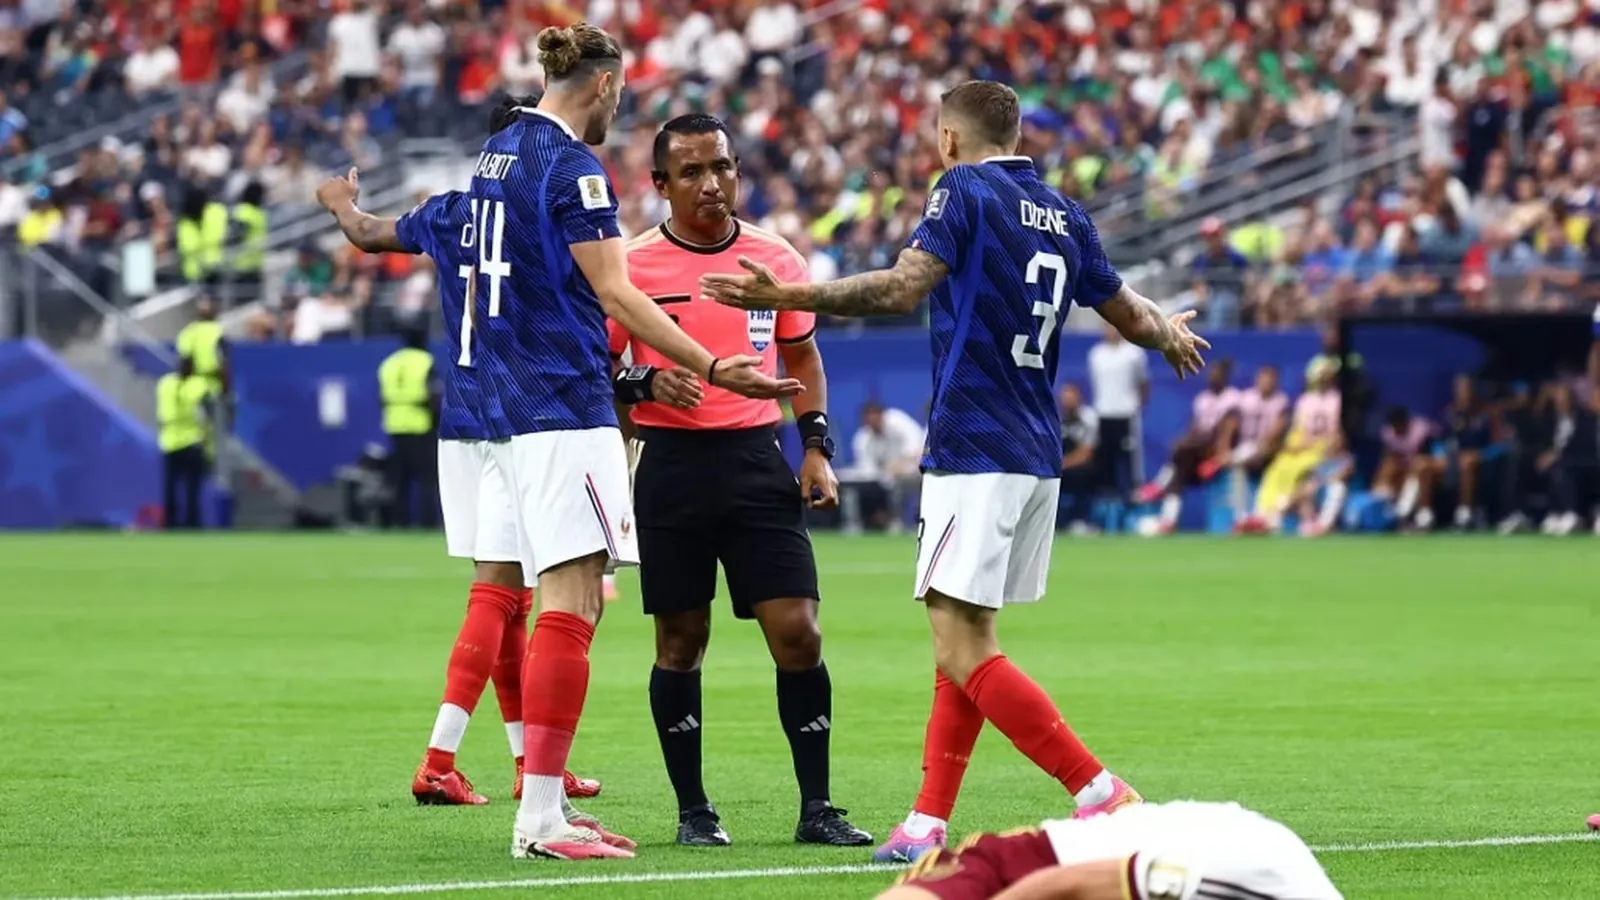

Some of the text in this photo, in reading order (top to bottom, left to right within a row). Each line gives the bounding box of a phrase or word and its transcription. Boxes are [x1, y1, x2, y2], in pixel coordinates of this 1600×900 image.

[1020, 199, 1069, 236] DIGNE
[750, 309, 773, 320] FIFA
[1010, 250, 1067, 369] 3
